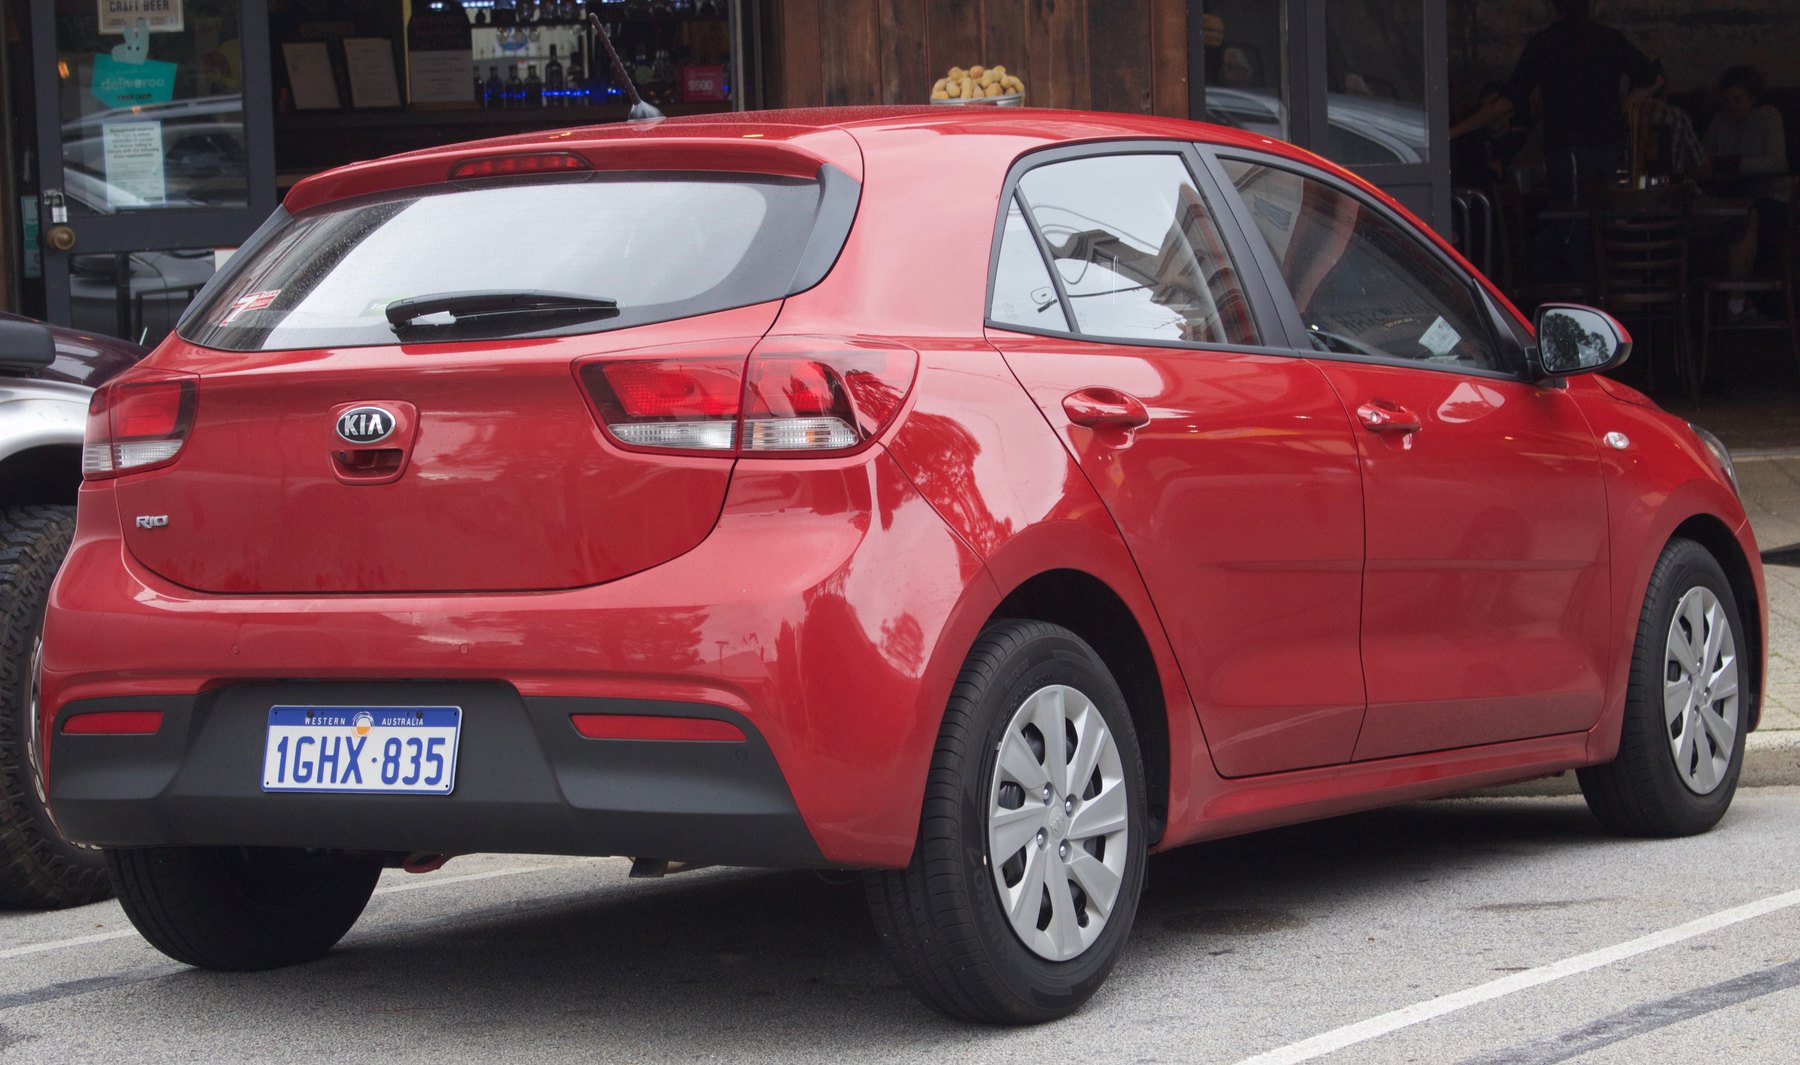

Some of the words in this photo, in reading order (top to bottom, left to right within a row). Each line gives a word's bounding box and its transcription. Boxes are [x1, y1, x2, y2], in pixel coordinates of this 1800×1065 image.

[109, 1, 138, 12] CRAFT
[143, 0, 169, 11] BEER
[101, 76, 165, 91] deliveroo
[344, 413, 384, 436] KIA
[135, 515, 169, 529] RIO
[304, 717, 346, 726] WESTERN
[381, 717, 424, 726] AUSTRALIA
